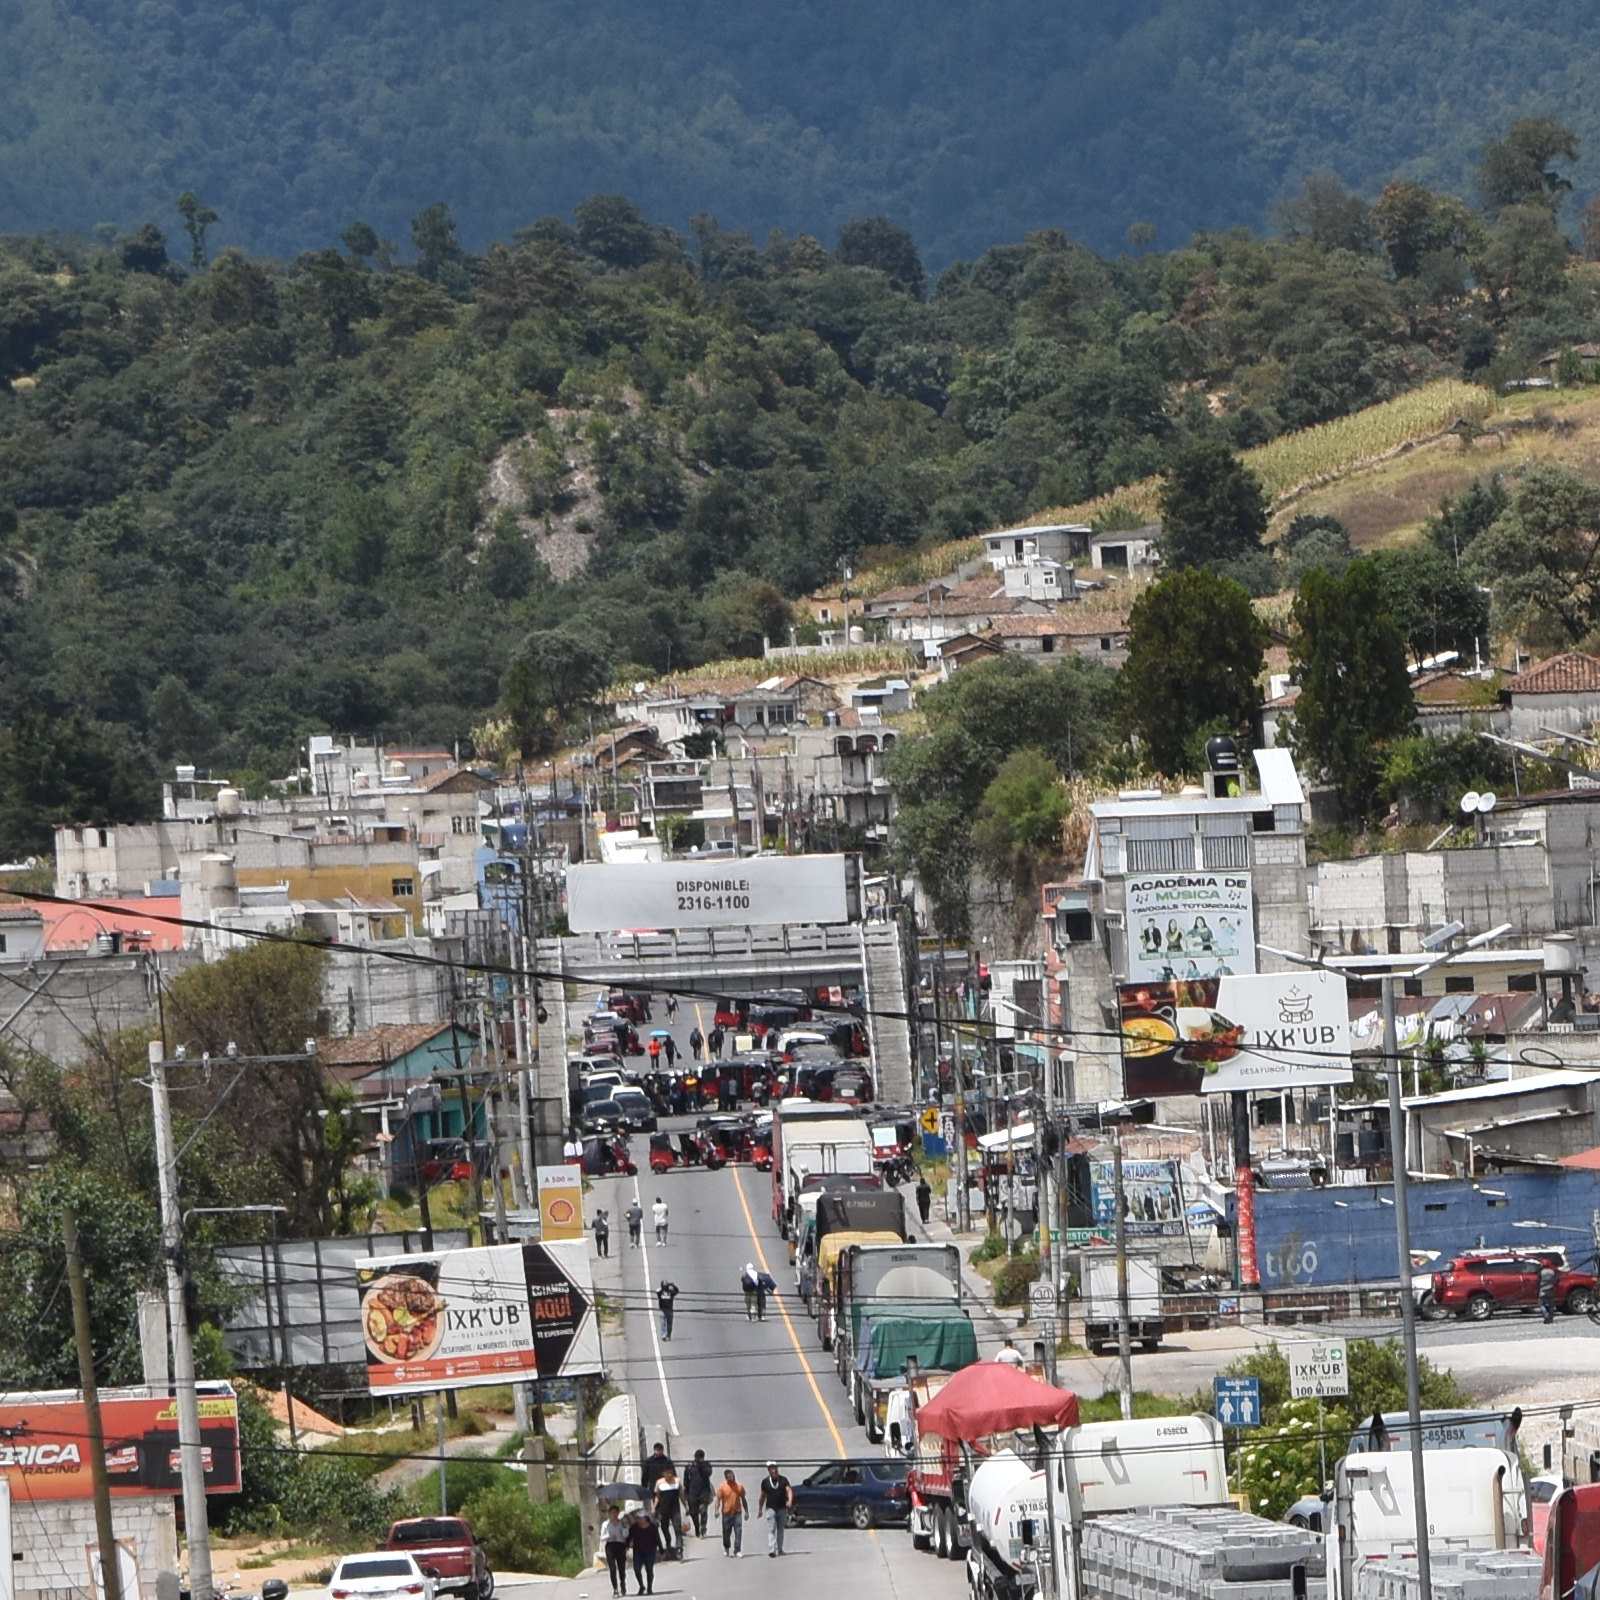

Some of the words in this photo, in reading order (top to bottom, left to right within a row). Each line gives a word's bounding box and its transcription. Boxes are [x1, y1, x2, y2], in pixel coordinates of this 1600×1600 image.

[1224, 878, 1247, 888] DE
[678, 895, 749, 910] 2316-1100
[1255, 1025, 1340, 1048] IXK'UB'
[447, 1303, 524, 1331] IXK'UB'
[1295, 1363, 1344, 1377] IXK'UB'
[1296, 1386, 1313, 1396] 100
